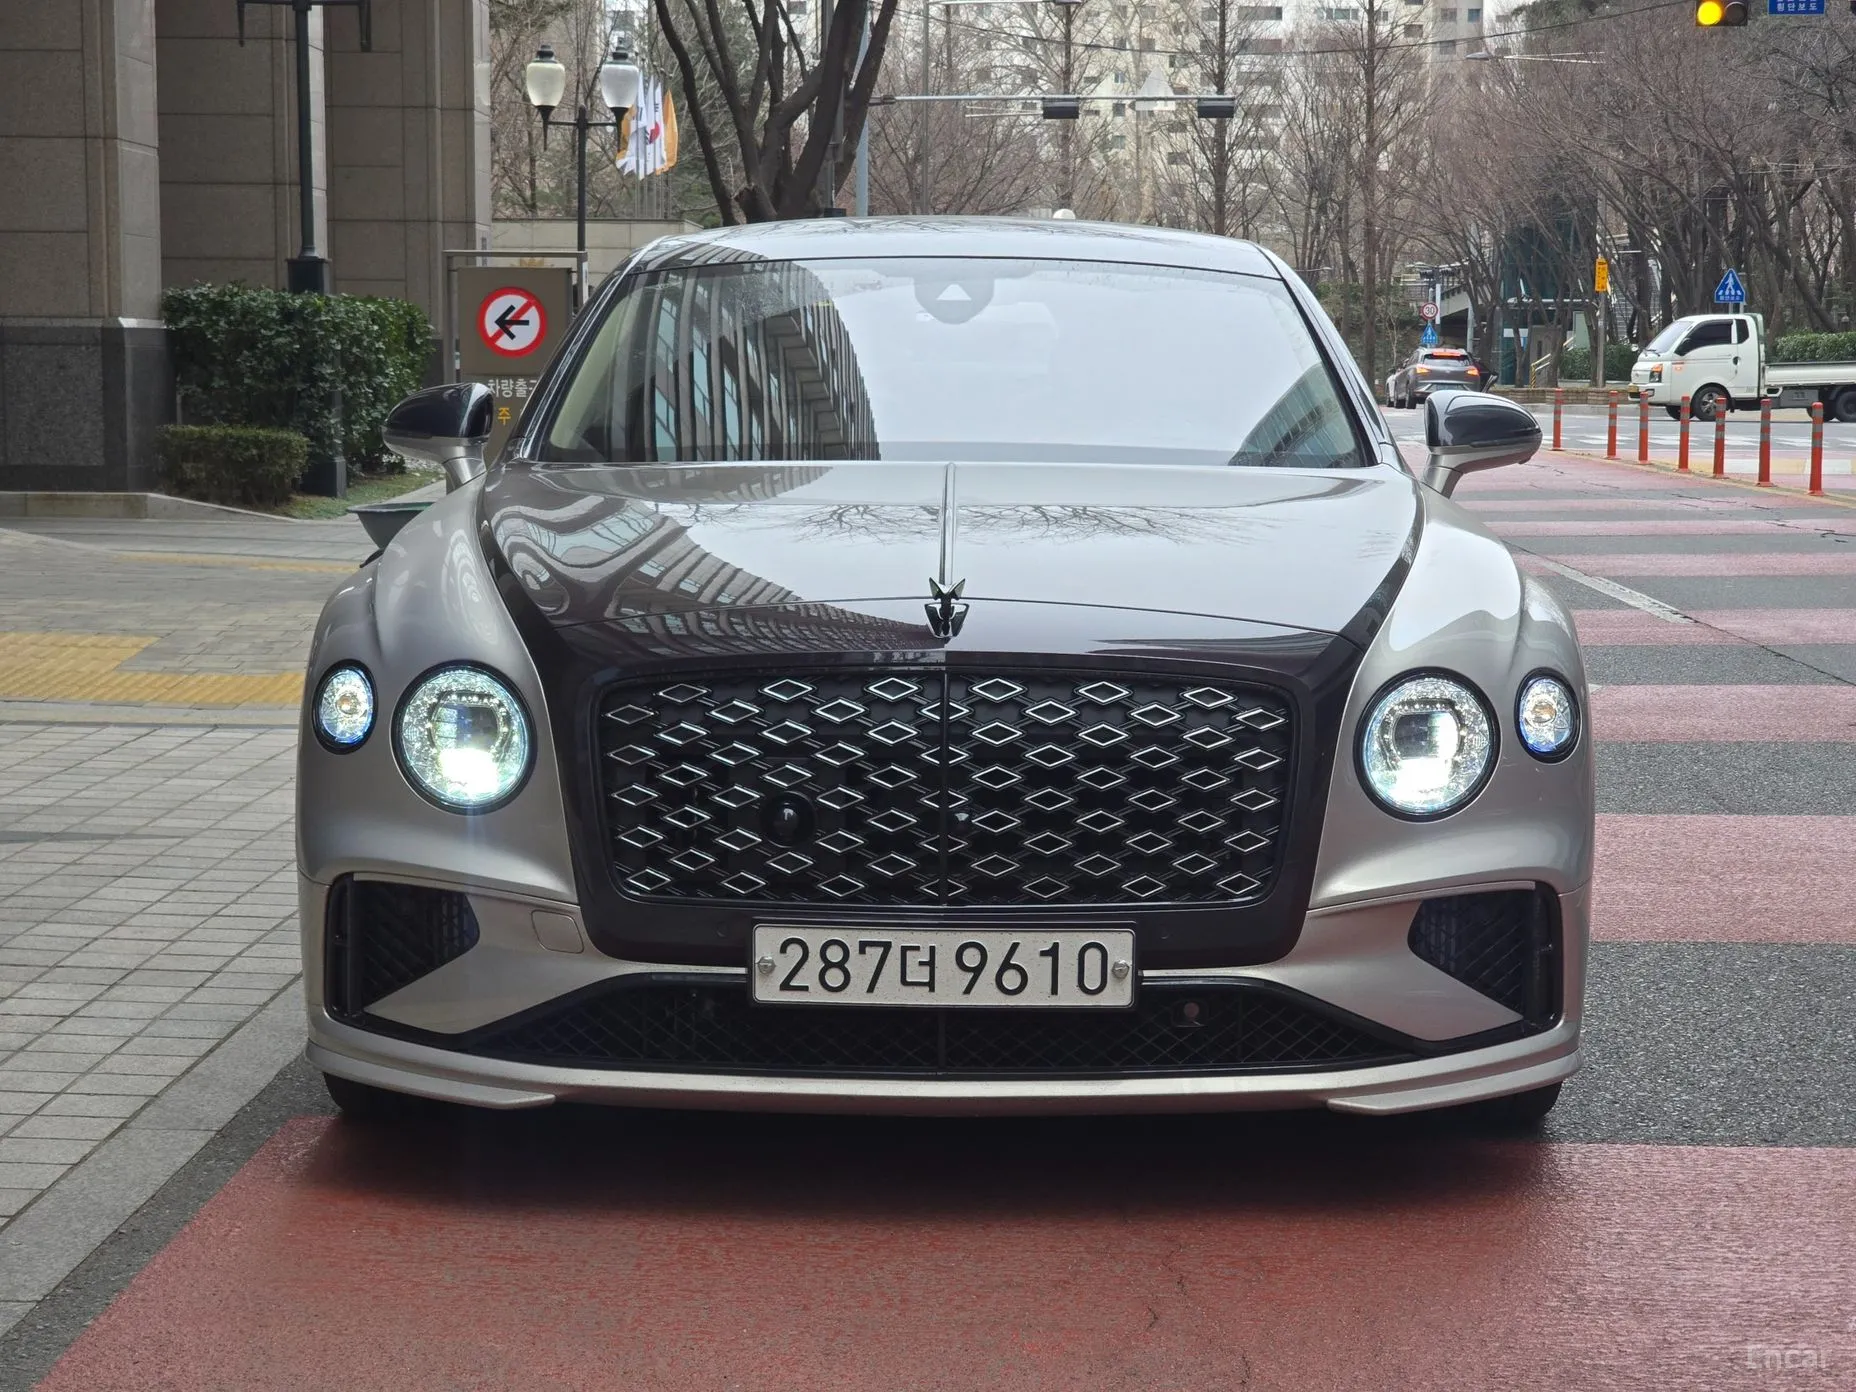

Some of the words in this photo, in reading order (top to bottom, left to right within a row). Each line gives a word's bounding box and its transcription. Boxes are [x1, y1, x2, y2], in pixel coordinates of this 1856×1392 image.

[1425, 306, 1436, 315] 30
[778, 936, 936, 993] 287더
[955, 940, 1109, 996] 9610
